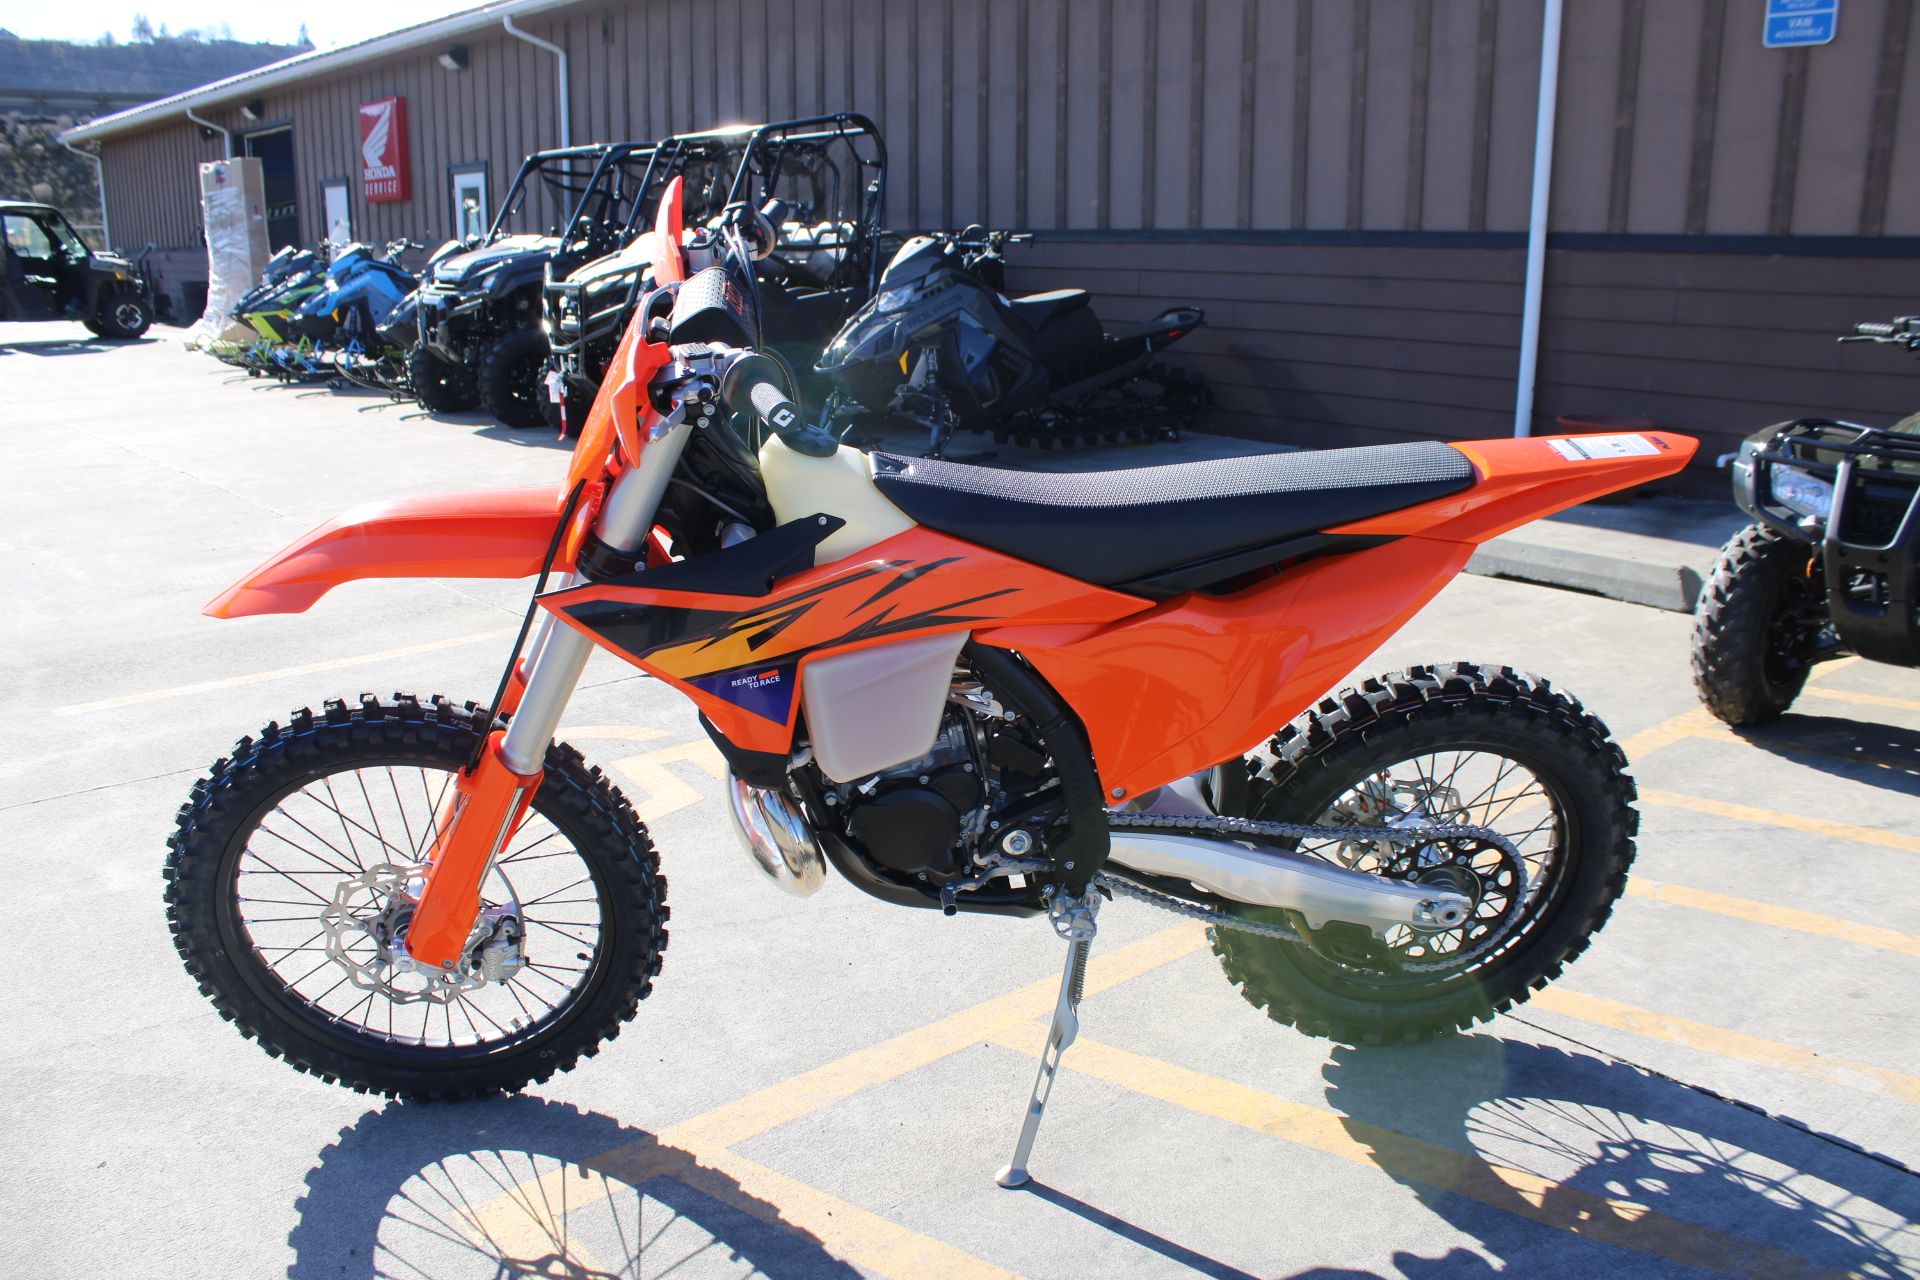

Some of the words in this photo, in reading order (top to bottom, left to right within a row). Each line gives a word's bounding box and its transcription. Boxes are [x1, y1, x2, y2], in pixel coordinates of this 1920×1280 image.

[363, 165, 396, 180] HONDA
[364, 180, 397, 196] SERVICE
[731, 675, 757, 687] READY
[749, 681, 759, 689] TO
[760, 675, 780, 687] RACE
